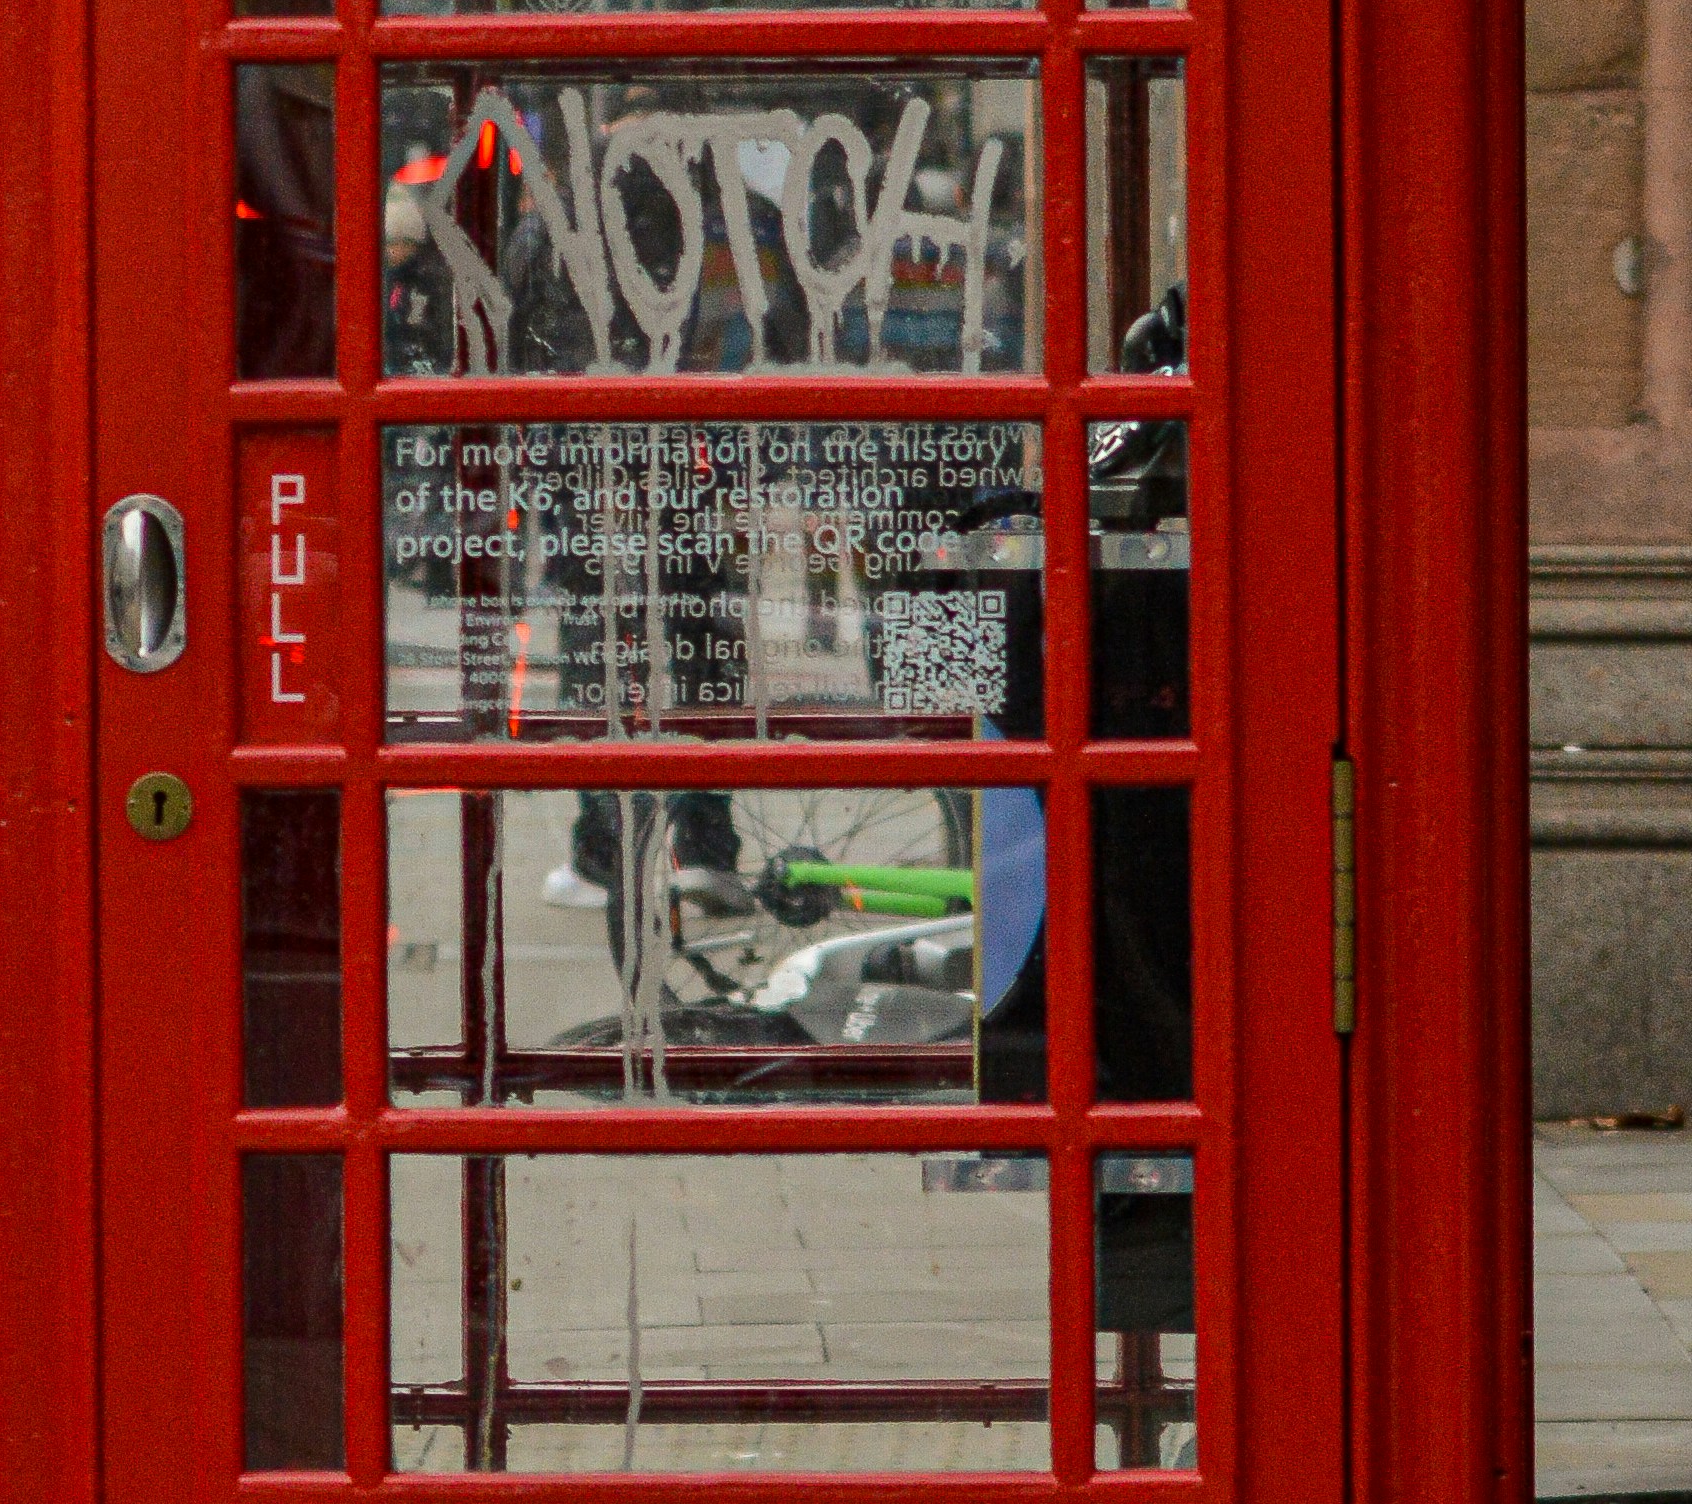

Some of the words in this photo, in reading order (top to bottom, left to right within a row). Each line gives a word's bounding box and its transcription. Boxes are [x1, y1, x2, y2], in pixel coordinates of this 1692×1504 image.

[396, 439, 456, 467] For
[462, 443, 549, 467] more
[559, 436, 758, 467] information
[769, 441, 811, 465] on
[825, 437, 879, 464] the
[889, 436, 1008, 472] history
[396, 482, 431, 514] of
[439, 482, 497, 513] the
[510, 481, 560, 516] K6,
[573, 480, 637, 511] and
[649, 485, 701, 510] our
[716, 481, 903, 511] restoration
[396, 530, 527, 566] project,
[540, 527, 647, 563] please
[659, 531, 736, 556] scan
[743, 526, 805, 555] the
[814, 524, 867, 554] QR
[877, 523, 961, 554] code
[271, 474, 306, 703] PULL
